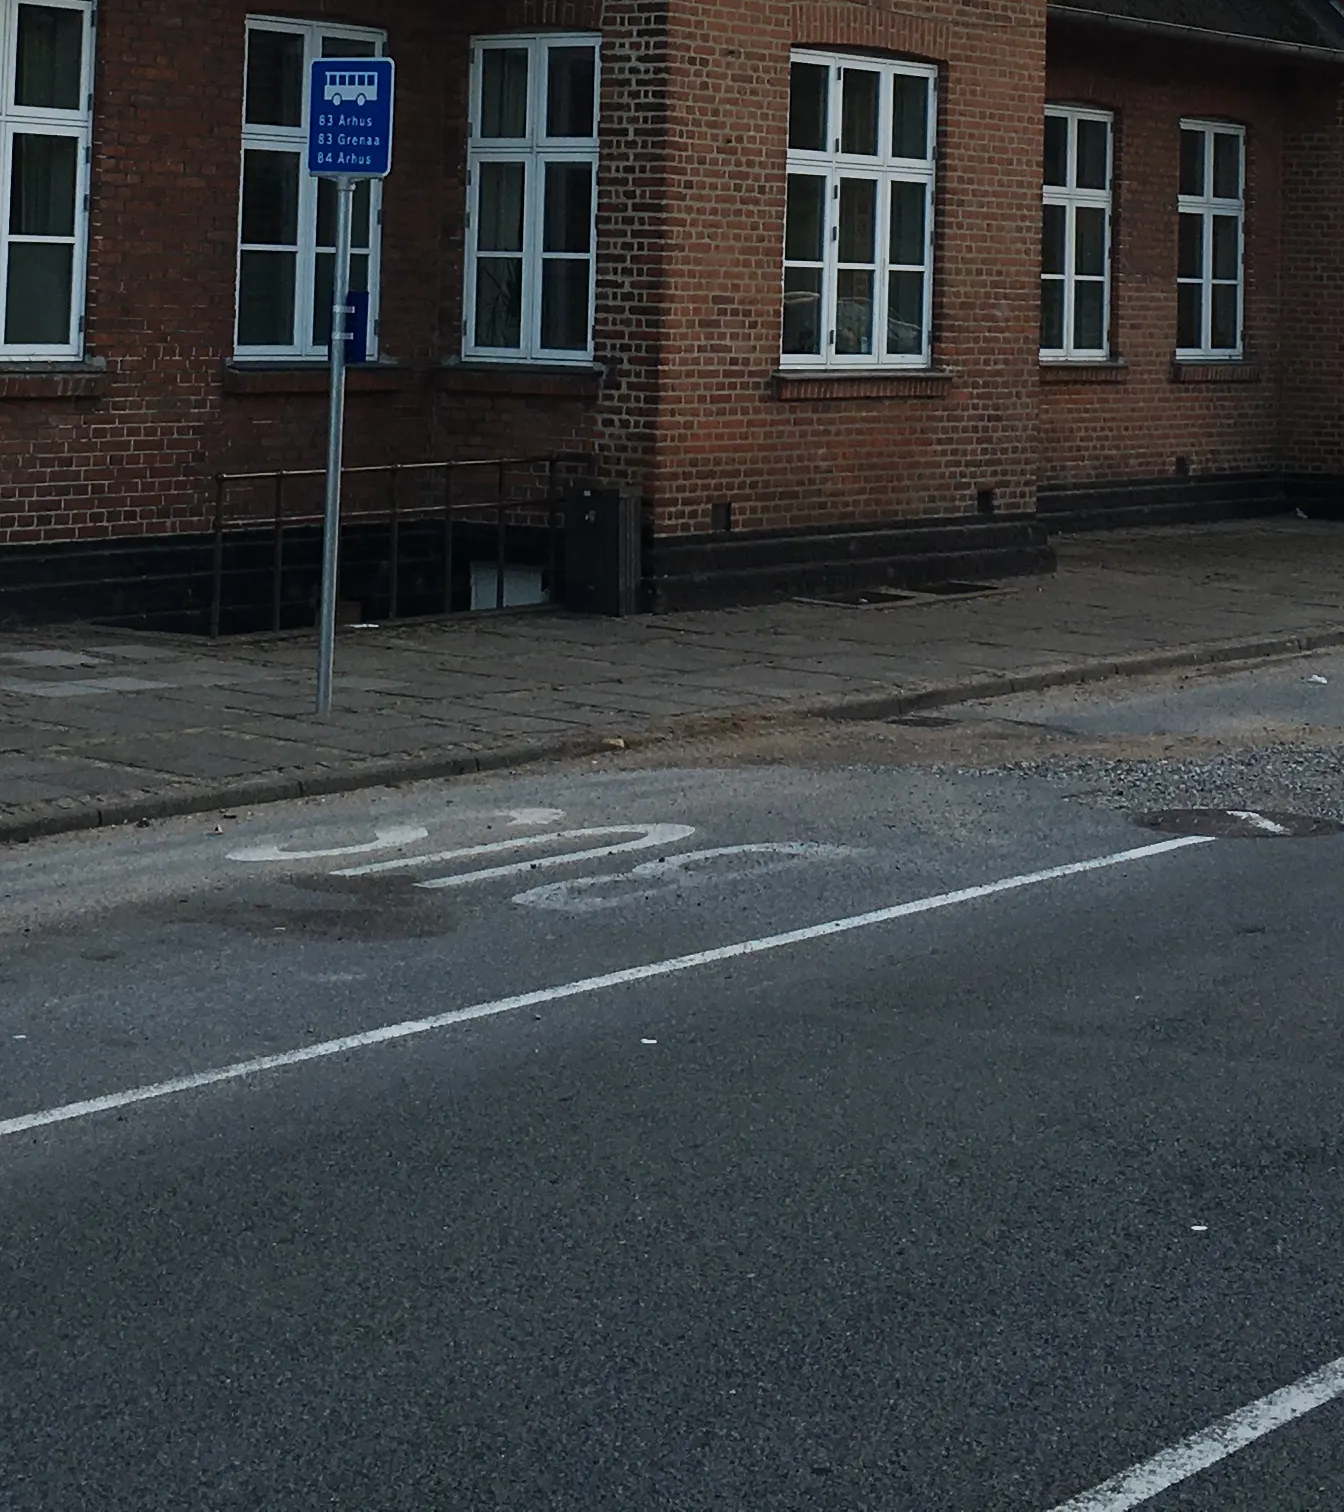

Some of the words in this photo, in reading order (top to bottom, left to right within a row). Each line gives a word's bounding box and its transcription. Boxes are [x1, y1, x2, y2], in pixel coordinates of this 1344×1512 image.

[318, 114, 333, 126] 83
[318, 133, 333, 145] 83
[337, 133, 380, 146] Grenaa
[317, 151, 333, 164] 84
